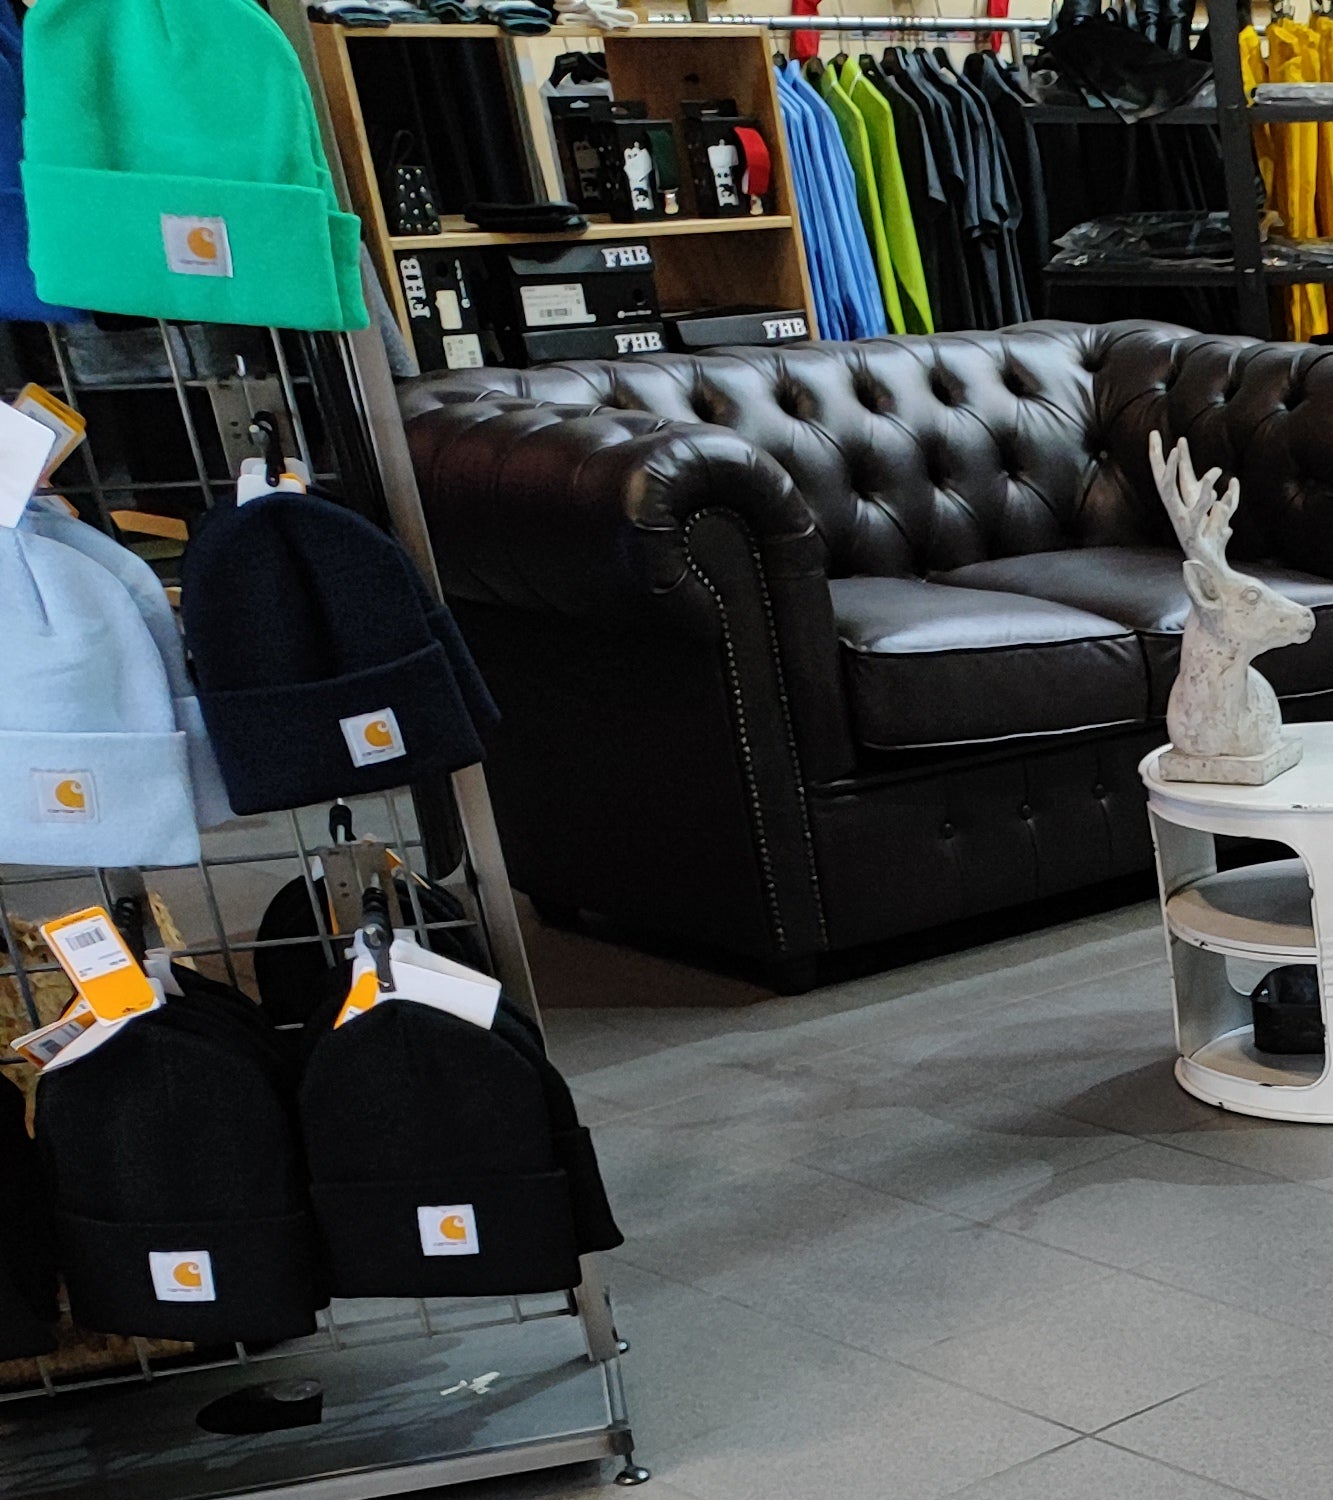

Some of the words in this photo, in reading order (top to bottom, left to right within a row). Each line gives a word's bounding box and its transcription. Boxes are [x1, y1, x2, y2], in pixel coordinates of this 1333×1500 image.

[600, 245, 652, 268] FHB
[400, 258, 431, 319] FHB
[762, 317, 807, 339] FHB
[614, 331, 663, 354] FHB
